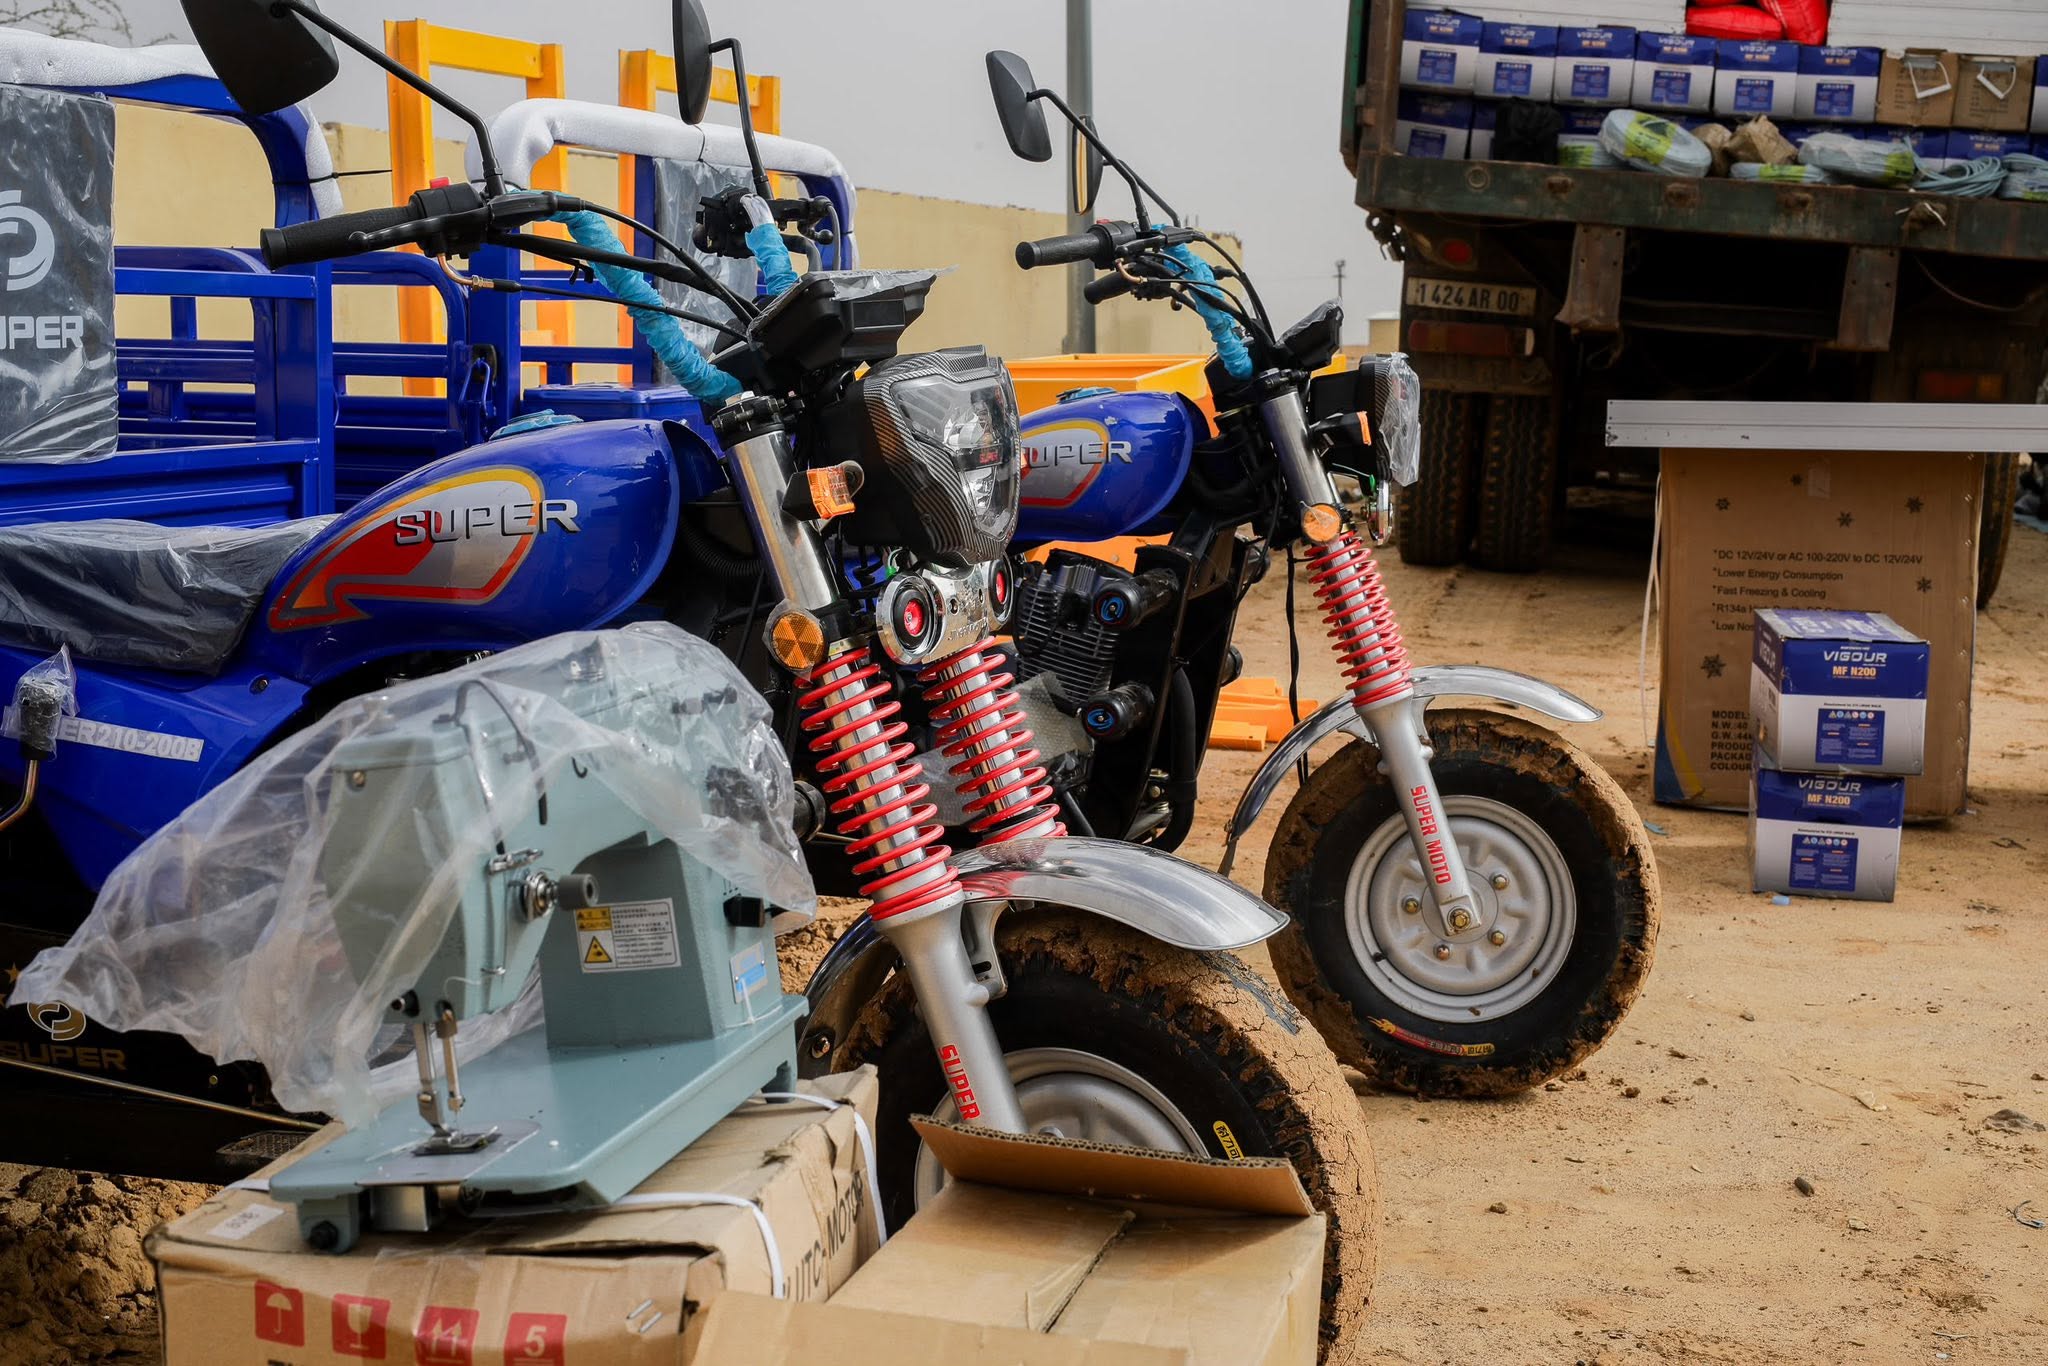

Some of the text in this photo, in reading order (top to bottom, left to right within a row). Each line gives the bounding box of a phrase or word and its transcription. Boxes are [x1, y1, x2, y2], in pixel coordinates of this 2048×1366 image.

[1469, 288, 1490, 309] AR
[0, 315, 83, 349] PER
[1022, 441, 1132, 469] UPER
[396, 499, 581, 544] SUPER
[1718, 550, 1733, 560] DC
[1777, 553, 1787, 561] or
[1789, 552, 1803, 561] AC
[1853, 554, 1862, 563] to
[1865, 554, 1880, 563] DC
[1717, 568, 1843, 582] Lower Energy Consumption
[1717, 586, 1737, 595] Fast
[1740, 587, 1779, 598] Freezing
[1791, 588, 1826, 599] Cooling
[1716, 604, 1746, 613] R134a
[1716, 622, 1735, 631] Low
[1824, 651, 1887, 663] VIGOUR
[1833, 665, 1876, 677] MF N200
[1799, 779, 1861, 792] VIGOUR
[1808, 794, 1850, 805] MF N200
[1411, 785, 1452, 884] SUPER MOTO
[938, 1045, 980, 1120] SUPER
[525, 1325, 547, 1357] 5
